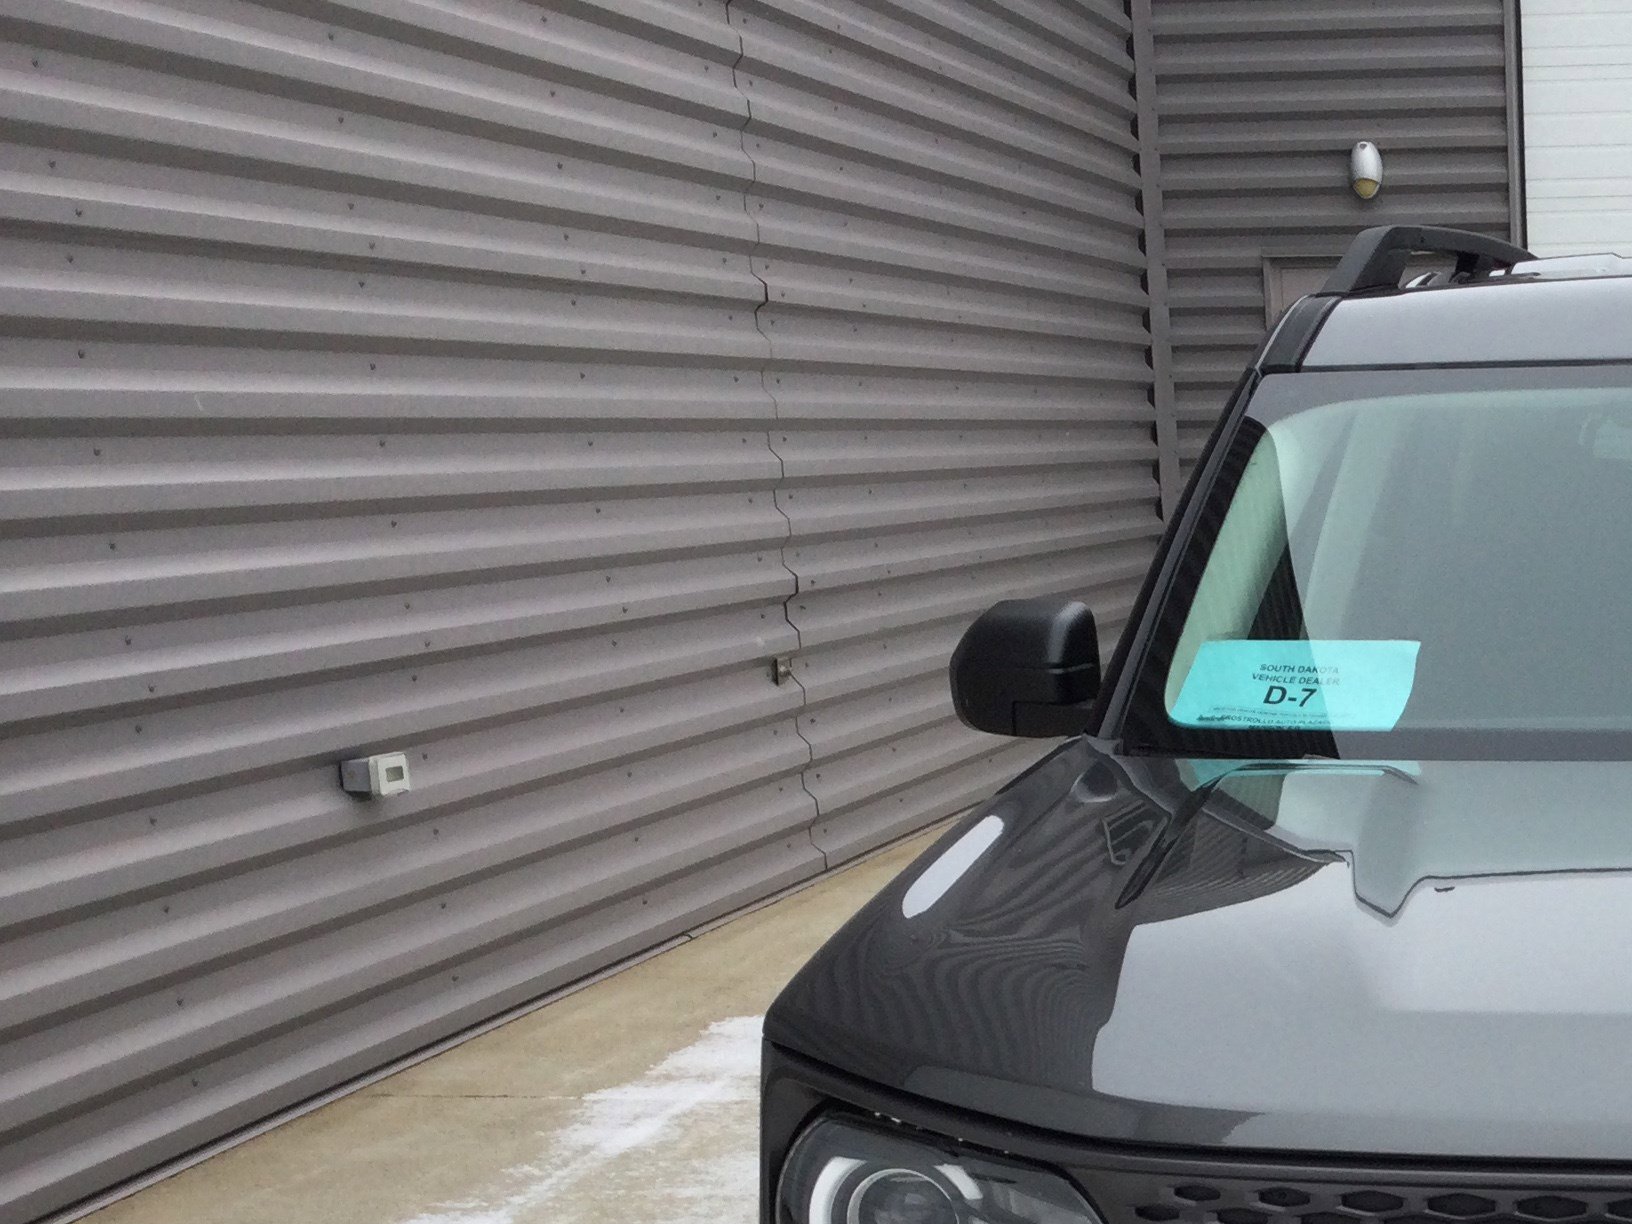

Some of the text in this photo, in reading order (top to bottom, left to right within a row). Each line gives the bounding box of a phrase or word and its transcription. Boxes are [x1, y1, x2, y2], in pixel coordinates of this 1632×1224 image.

[1259, 663, 1339, 674] SOUTH DAKOTA
[1252, 672, 1297, 685] VEHICLE
[1263, 685, 1318, 707] D-7
